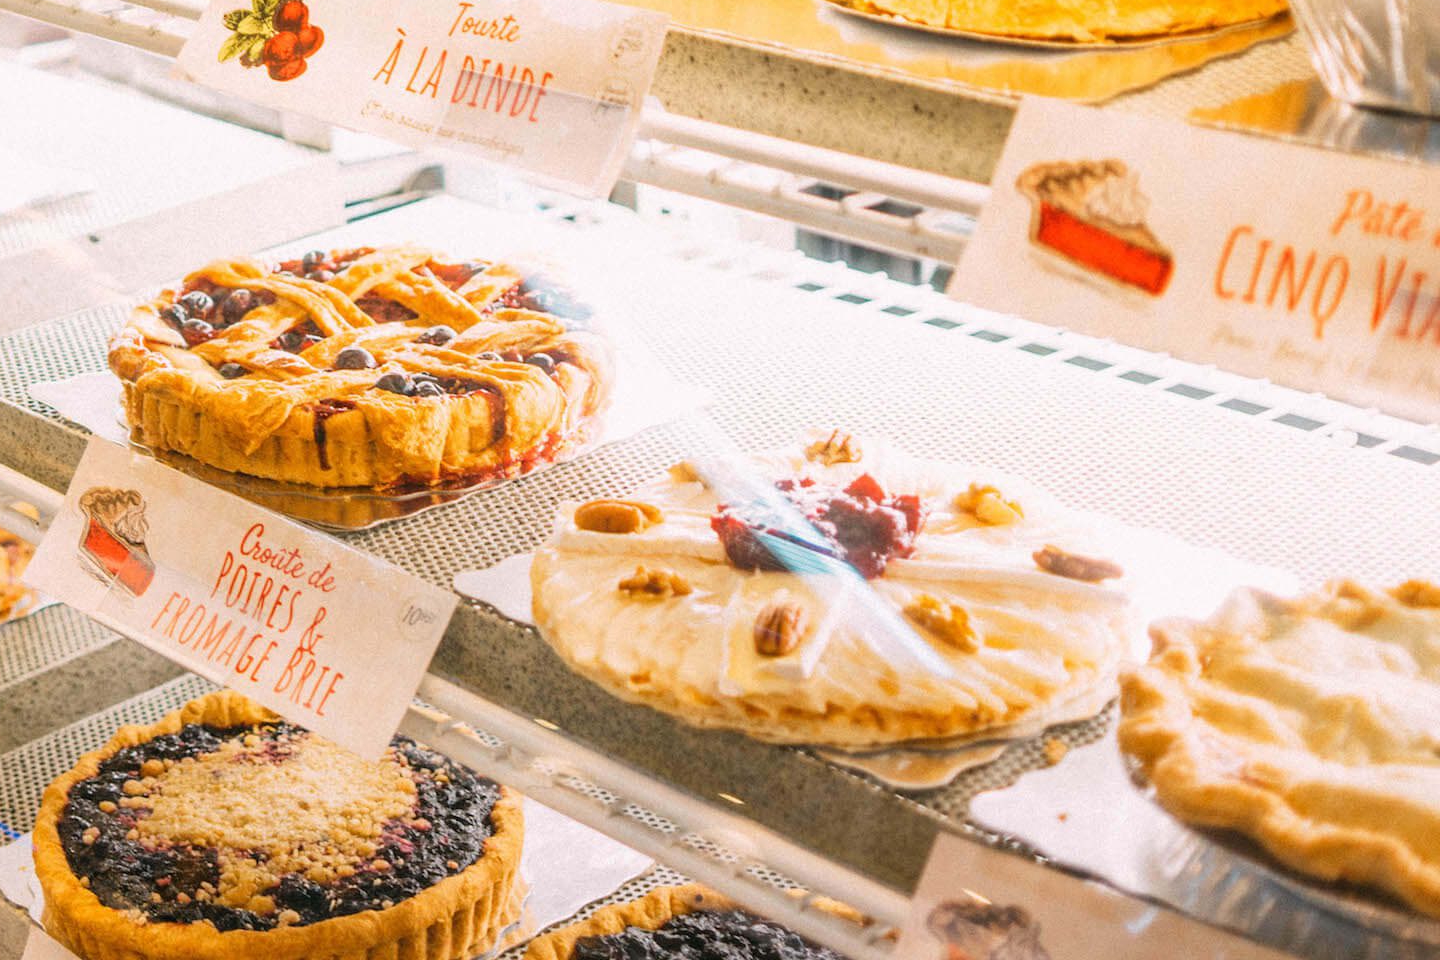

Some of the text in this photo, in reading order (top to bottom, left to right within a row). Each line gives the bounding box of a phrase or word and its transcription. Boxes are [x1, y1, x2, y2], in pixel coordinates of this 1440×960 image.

[448, 2, 520, 42] Tourte
[372, 27, 406, 85] À
[405, 45, 447, 99] LA
[450, 55, 554, 123] DINDE
[1214, 224, 1350, 340] CINQ
[210, 551, 326, 656] POIRES &
[240, 523, 336, 593] Croûte de
[151, 591, 345, 717] FROMAGE BRIE
